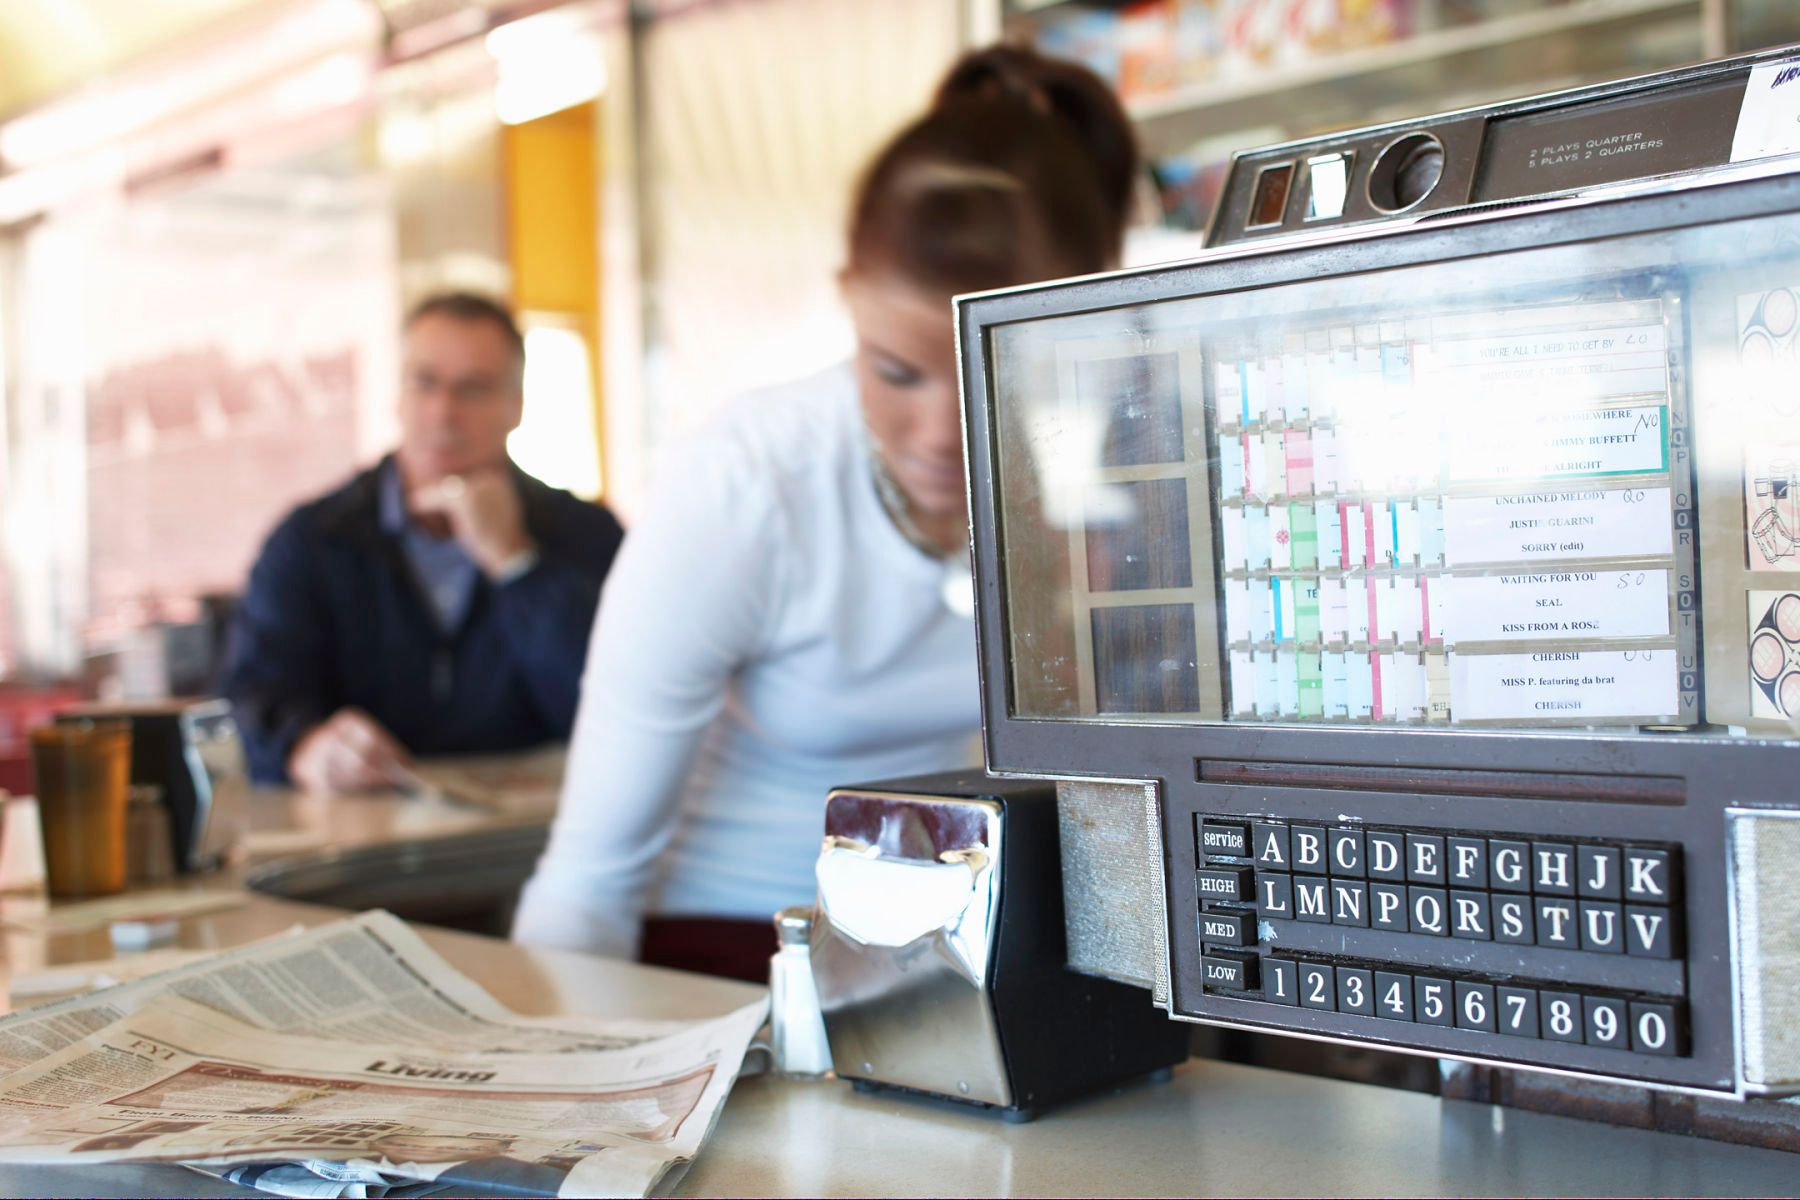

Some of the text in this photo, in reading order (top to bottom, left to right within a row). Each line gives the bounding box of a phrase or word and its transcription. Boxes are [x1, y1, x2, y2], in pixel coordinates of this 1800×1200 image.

[1530, 132, 1643, 158] 2 PLAYS QUARTER
[1528, 139, 1664, 168] 5 PLAYS 2 QUARTERS
[1512, 346, 1528, 356] ALL
[1568, 342, 1580, 351] TO
[1582, 340, 1598, 350] GET
[1602, 339, 1614, 349] BY
[1589, 434, 1638, 446] BUFFETT
[1676, 452, 1687, 464] P
[1552, 460, 1602, 471] ALRIGHT
[1495, 491, 1606, 506] UNCHAINED MELODY
[1675, 493, 1688, 507] Q
[1548, 516, 1594, 528] GUARINI
[1679, 532, 1690, 546] R
[1521, 541, 1584, 552] SORRY (edit)
[1500, 572, 1597, 585] WAITING FOR YOU
[1679, 574, 1690, 588] S
[1536, 598, 1563, 608] SEAL
[1502, 623, 1526, 632] KISS
[1528, 622, 1558, 632] FROM
[1561, 622, 1568, 630] A
[1681, 614, 1692, 626] T
[1532, 652, 1580, 662] CHERISH
[1682, 656, 1694, 669] U
[1501, 676, 1615, 687] MISS P. featuring da brat
[1534, 700, 1582, 710] CHERISH
[1684, 696, 1695, 708] V
[1204, 831, 1244, 849] service
[1260, 832, 1664, 896] A B C D E F G H J K
[1200, 878, 1236, 894] HIGH
[1264, 880, 1663, 950] L M N P Q R S T U V
[1204, 922, 1236, 938] MED
[1208, 965, 1236, 981] LOW
[1274, 968, 1667, 1050] 1 2 3 4 5 6 7 8 9 0
[365, 1060, 498, 1083] Living
